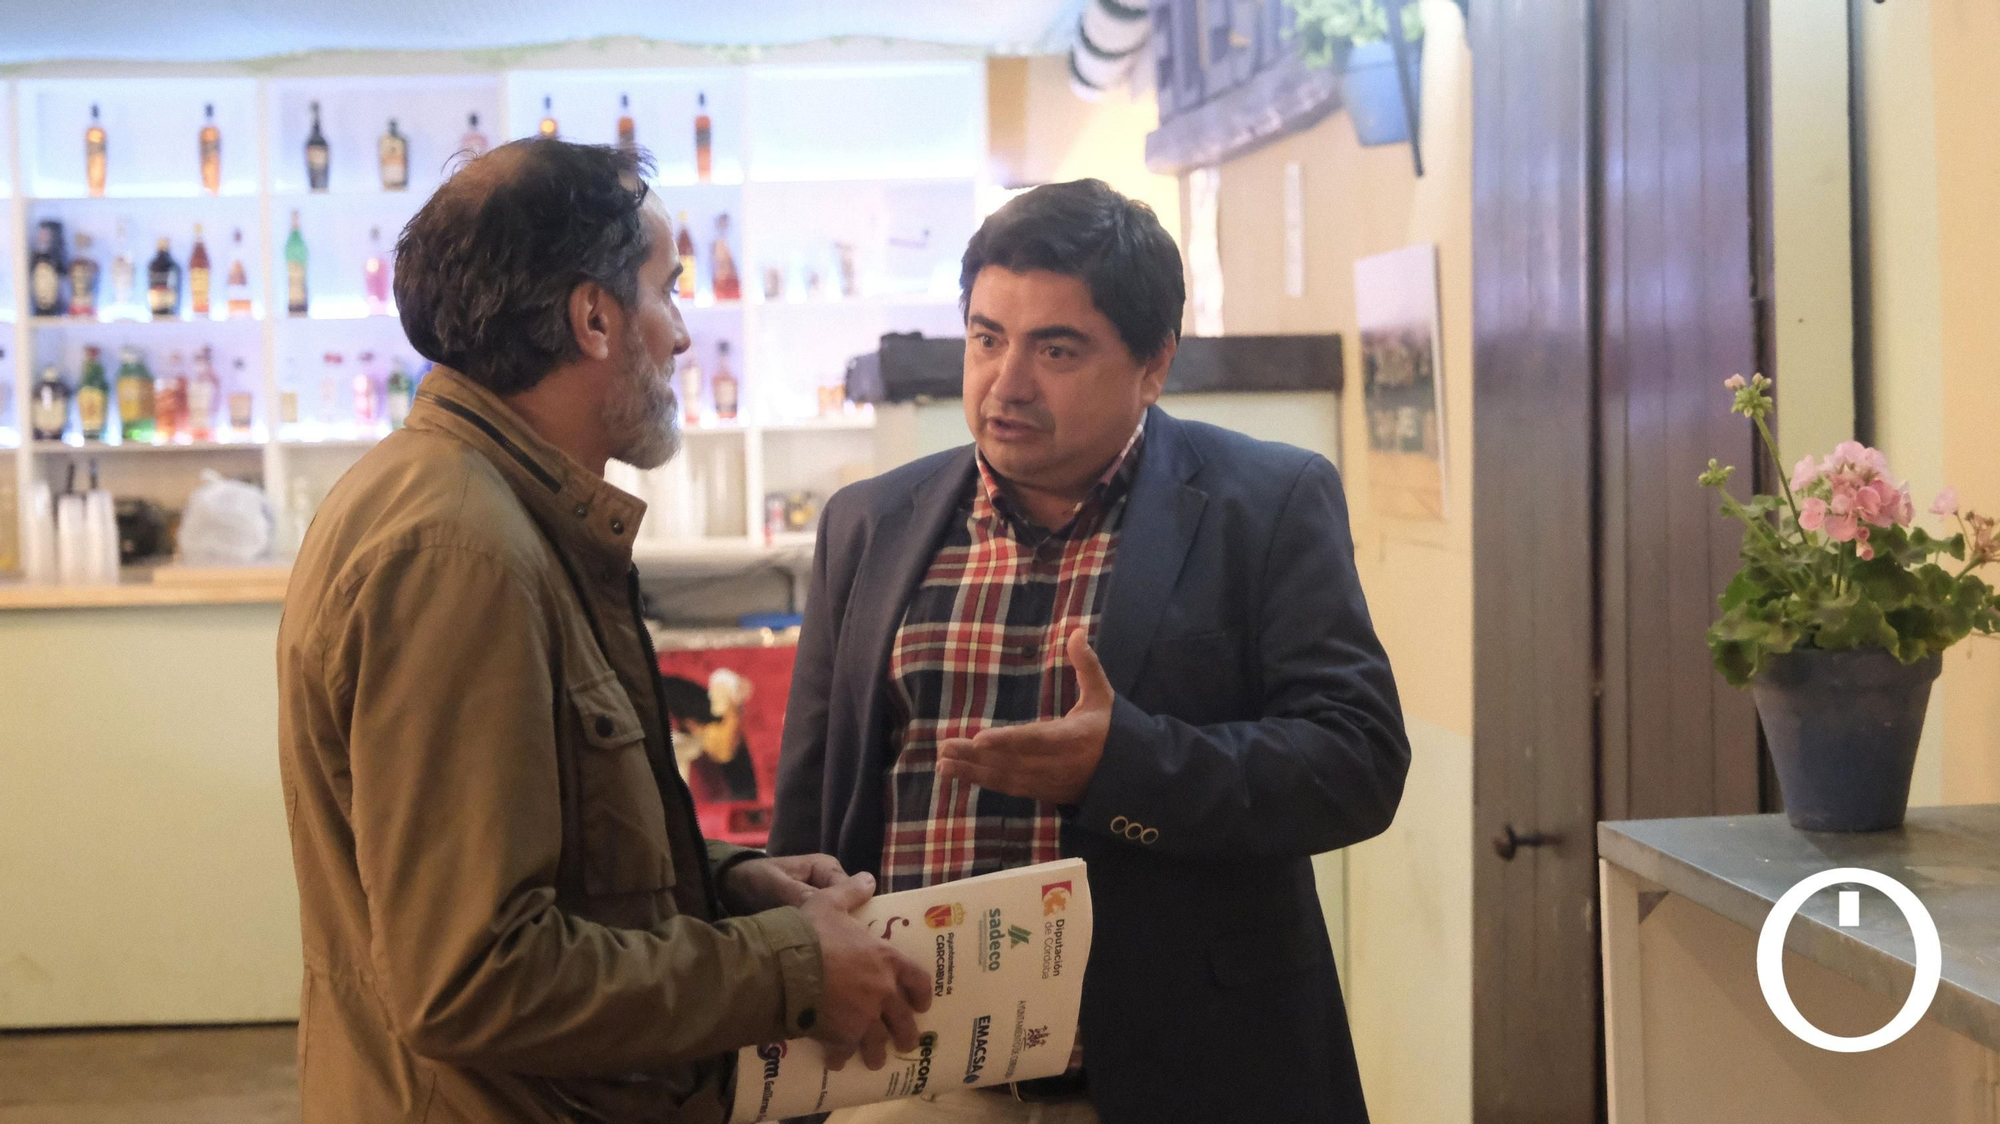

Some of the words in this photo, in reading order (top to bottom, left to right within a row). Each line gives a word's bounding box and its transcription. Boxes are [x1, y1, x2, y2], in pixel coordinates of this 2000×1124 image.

[988, 908, 1006, 971] sadeco
[1044, 921, 1054, 935] de
[1053, 918, 1065, 977] Diputación
[934, 934, 945, 997] CARCABUEY
[946, 932, 956, 985] Ayuntamiento
[1042, 937, 1054, 980] Córdoba
[970, 1015, 991, 1073] EMACSA
